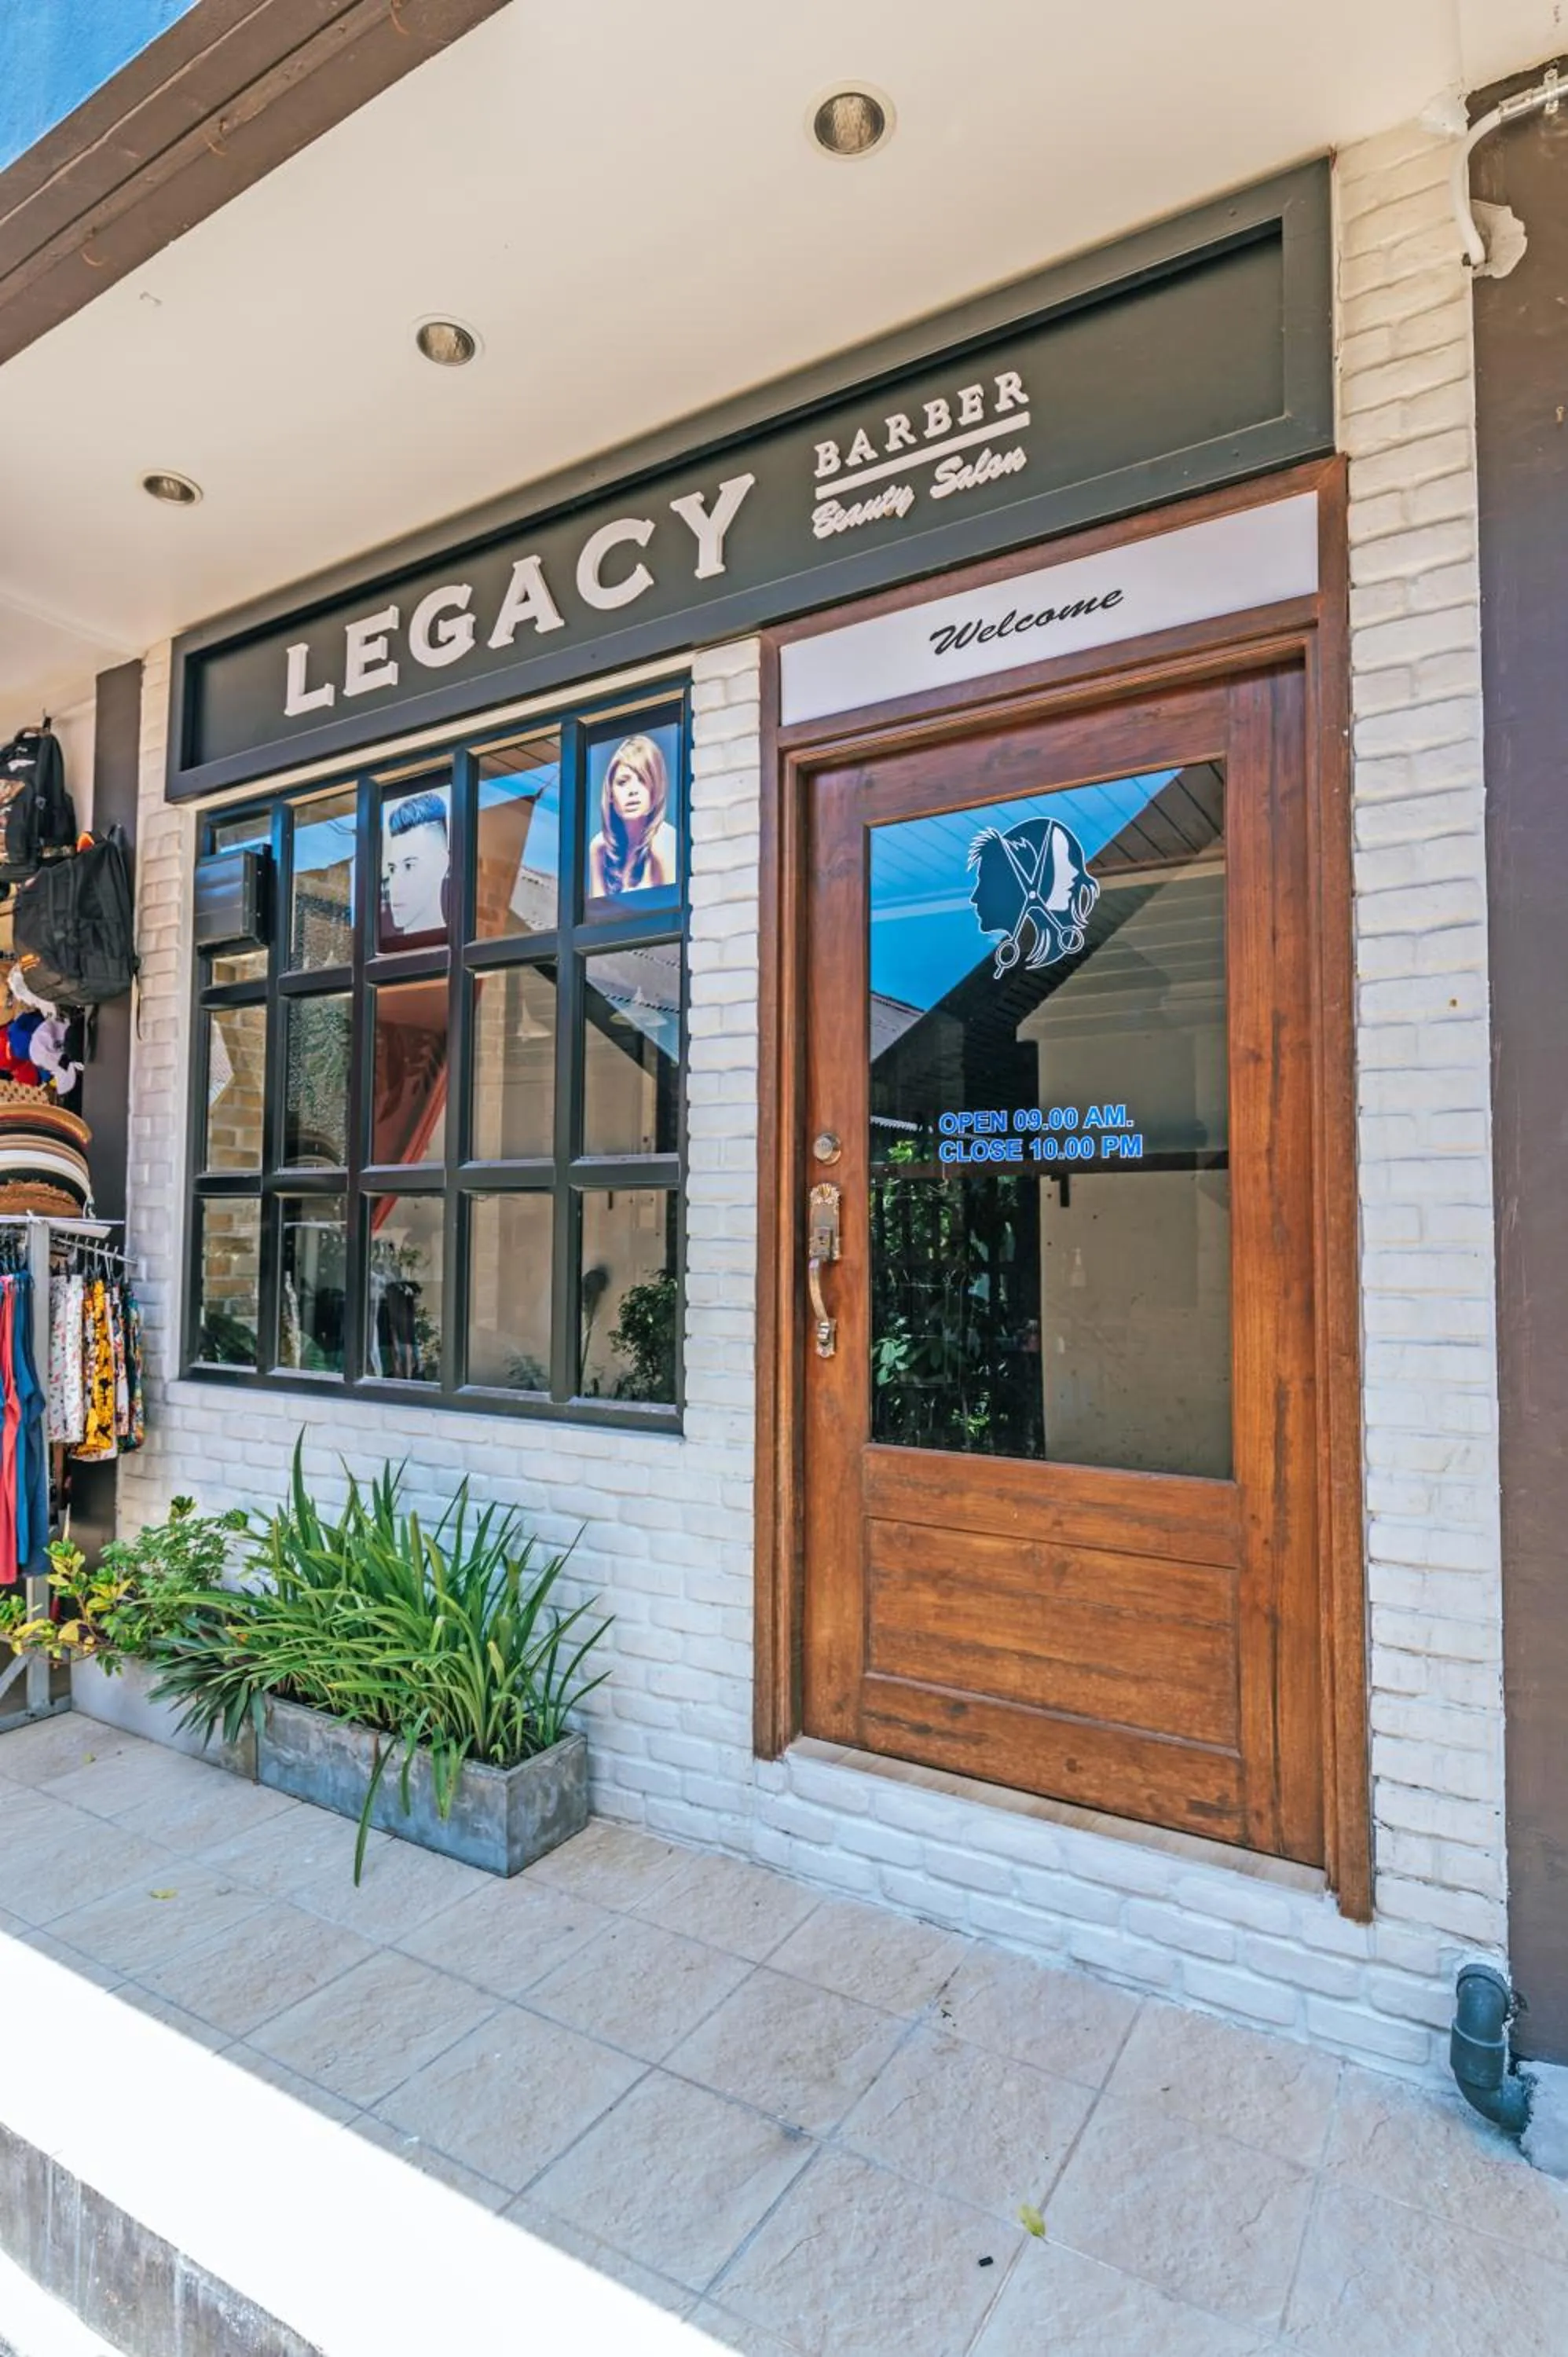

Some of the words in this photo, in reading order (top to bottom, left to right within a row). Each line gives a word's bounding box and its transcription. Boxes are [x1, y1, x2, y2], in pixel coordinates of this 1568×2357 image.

[814, 371, 1029, 478] BARBER
[811, 485, 915, 540] Beauty
[929, 446, 1028, 499] Salon
[284, 473, 755, 717] LEGACY
[929, 589, 1124, 654] Welcome
[939, 1110, 1008, 1135] OPEN
[1013, 1107, 1079, 1131] 09.00
[1083, 1105, 1135, 1129] AM.
[939, 1138, 1024, 1163] CLOSE
[1029, 1136, 1095, 1160] 10.00
[1101, 1134, 1143, 1160] PM
